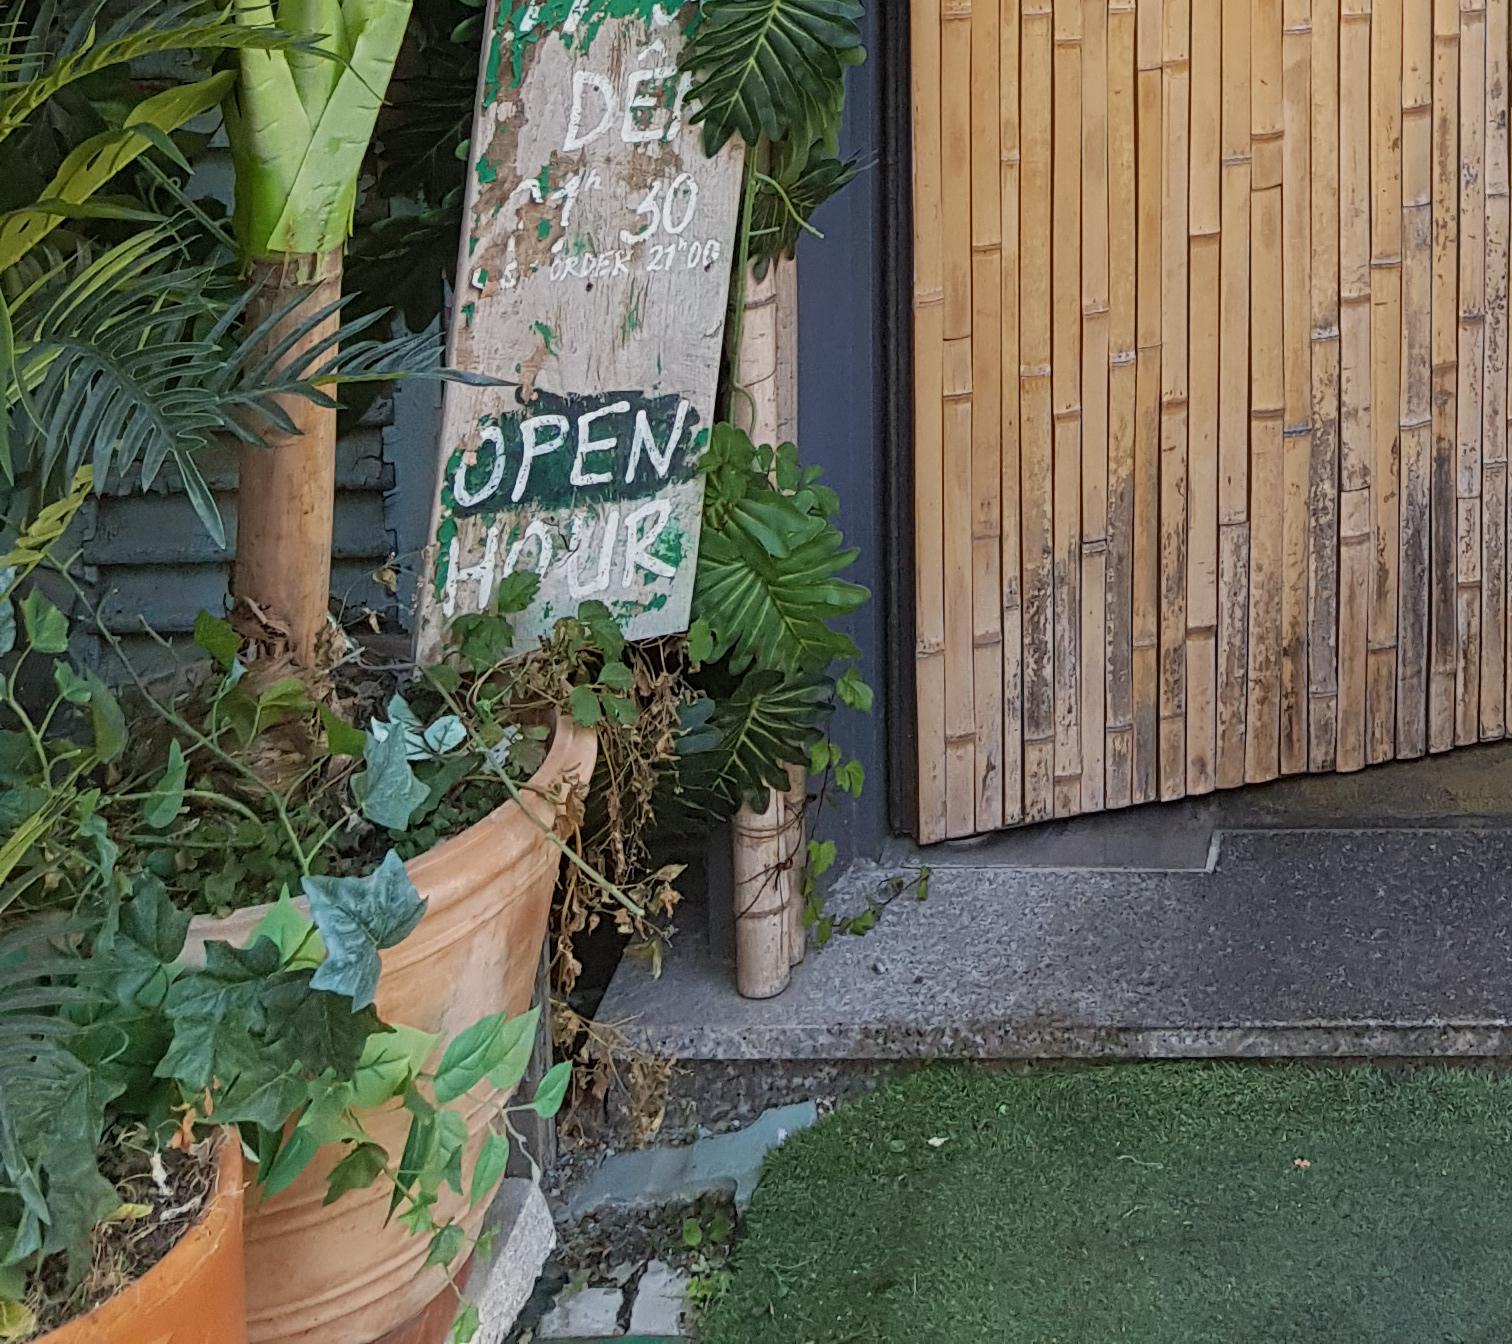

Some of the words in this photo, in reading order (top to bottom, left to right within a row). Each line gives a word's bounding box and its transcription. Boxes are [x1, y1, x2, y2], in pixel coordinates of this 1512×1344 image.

[550, 249, 635, 281] ORDER
[453, 400, 690, 507] OPEN
[443, 499, 676, 617] HOUR
